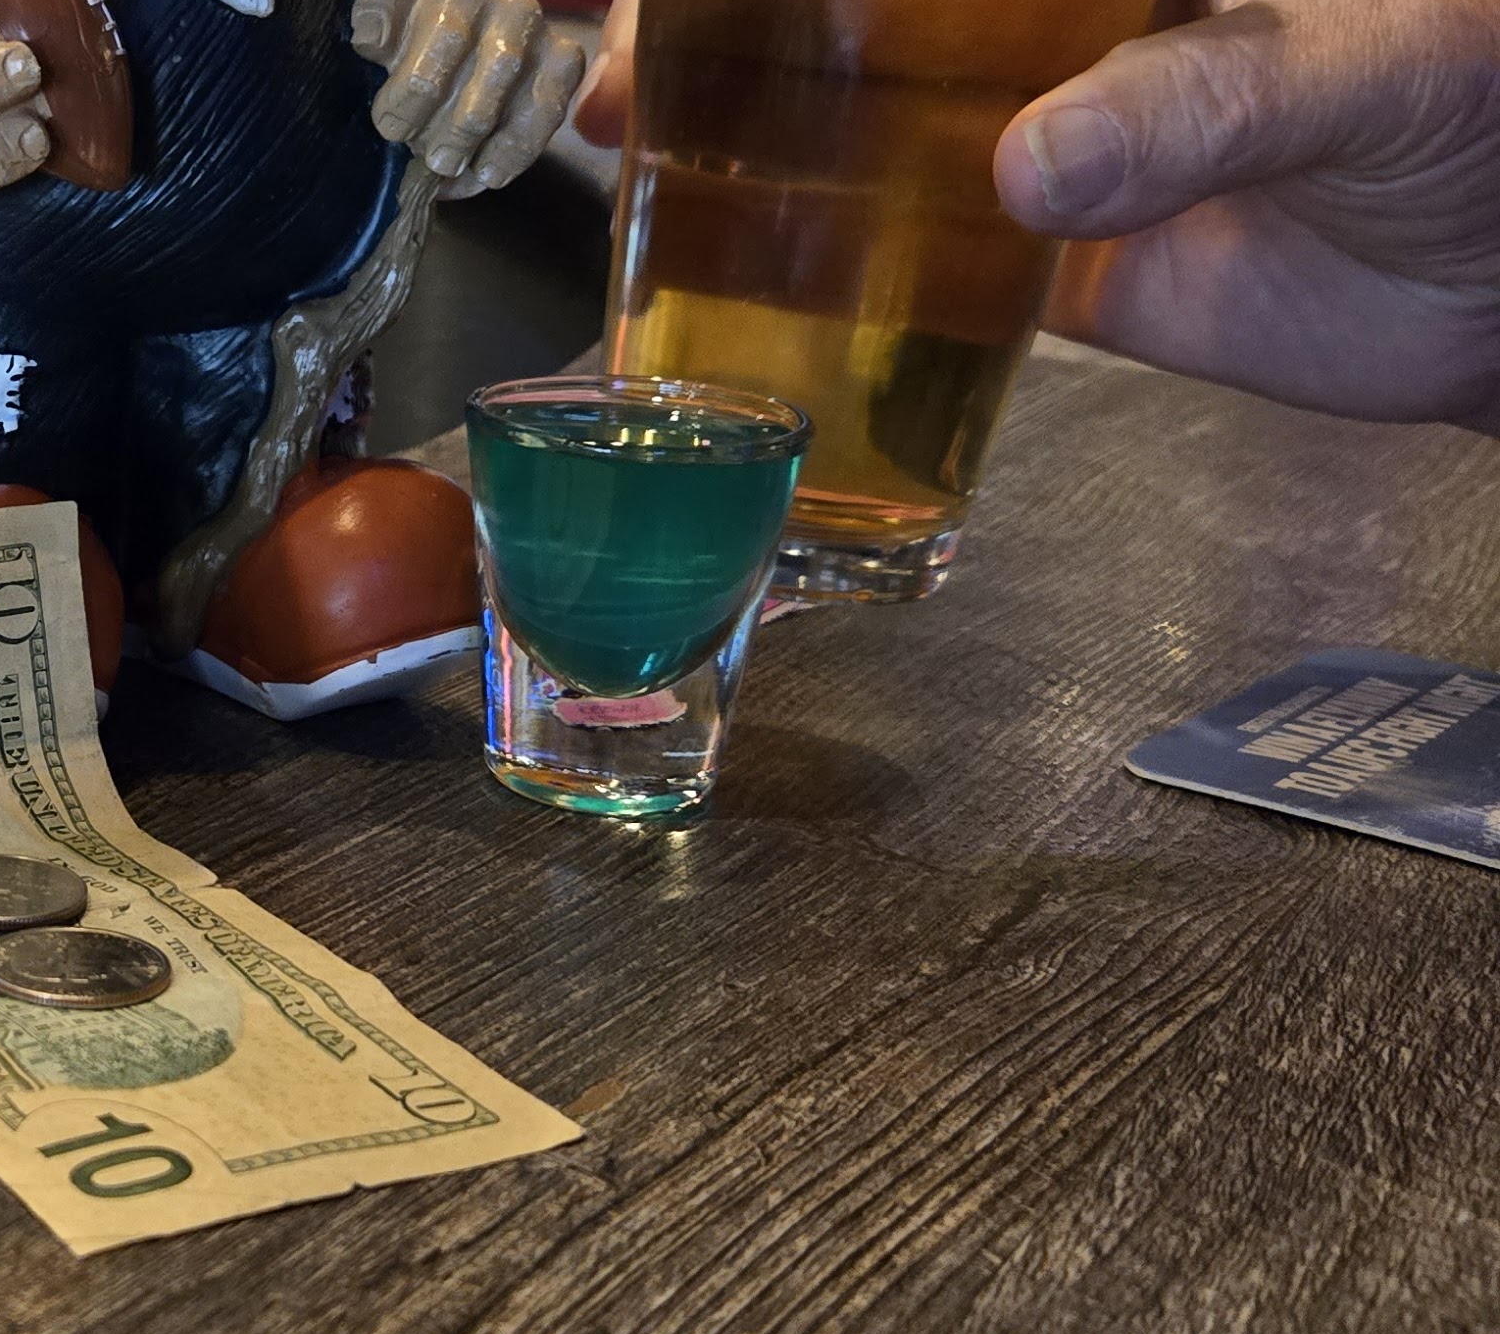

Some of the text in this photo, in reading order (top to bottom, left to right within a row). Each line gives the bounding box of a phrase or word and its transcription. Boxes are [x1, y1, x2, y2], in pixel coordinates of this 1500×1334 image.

[1319, 738, 1409, 772] UFC
[143, 915, 209, 975] WE TRUST
[368, 1070, 477, 1124] 10
[35, 1111, 194, 1199] 10
